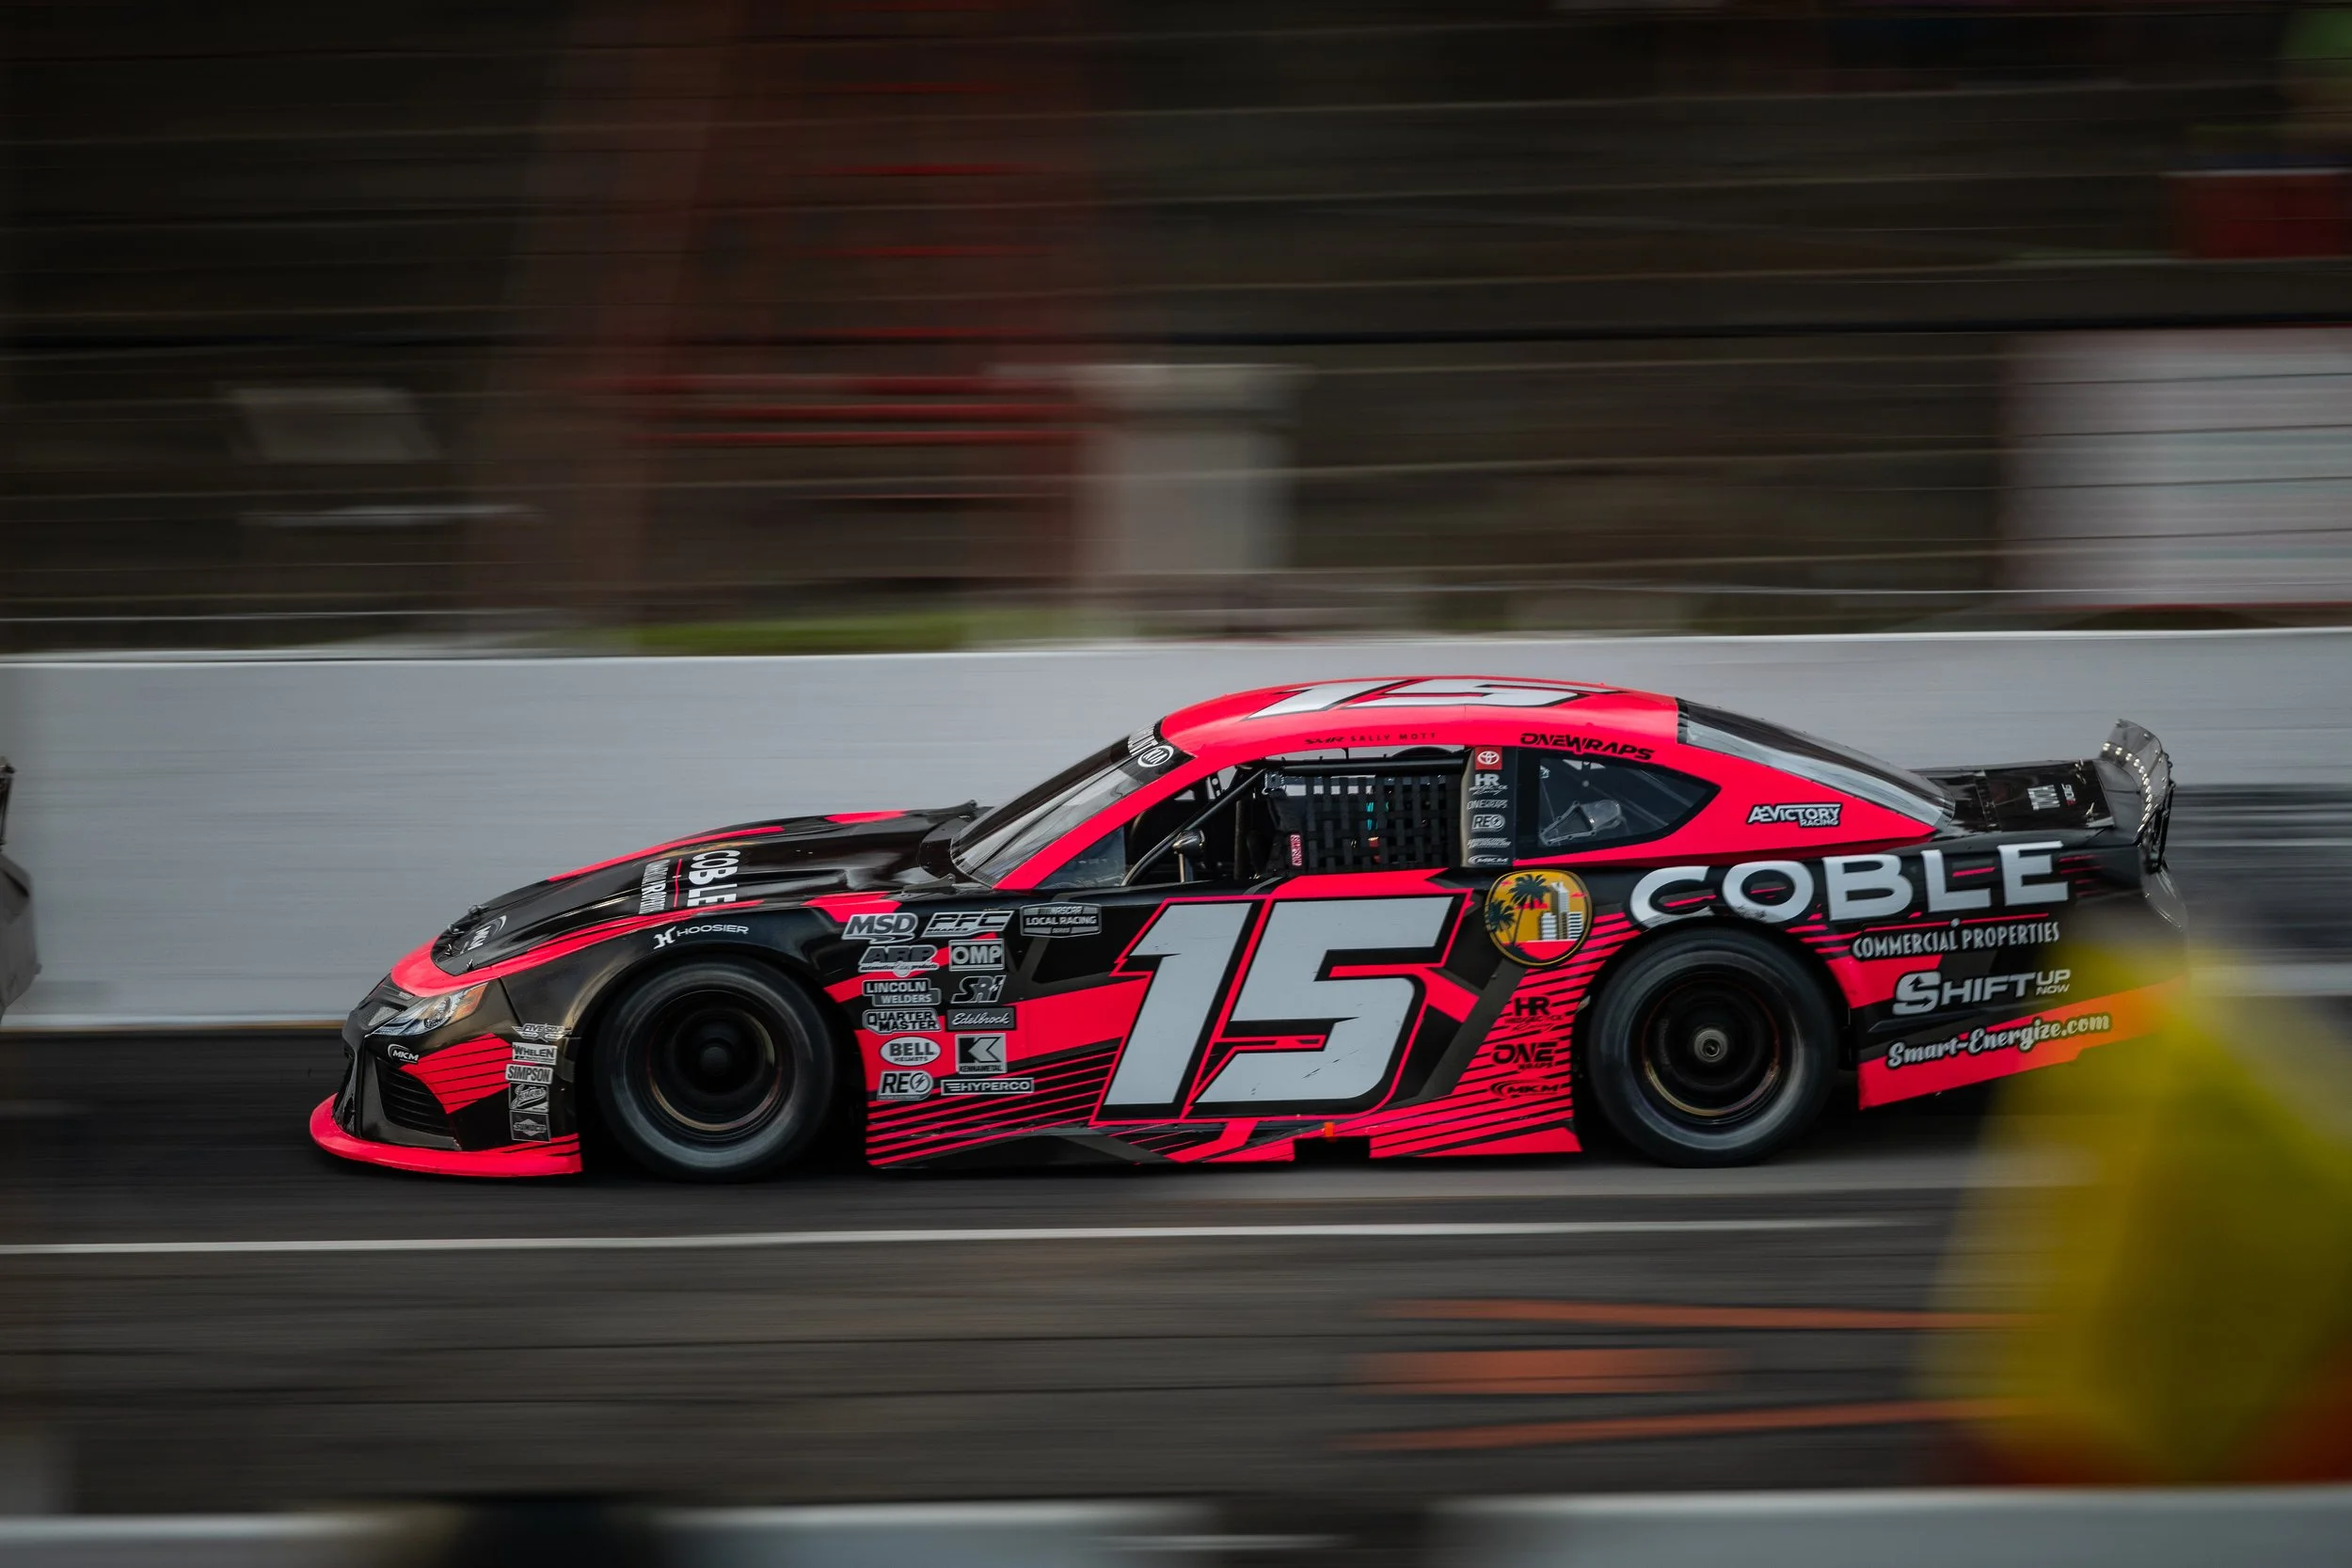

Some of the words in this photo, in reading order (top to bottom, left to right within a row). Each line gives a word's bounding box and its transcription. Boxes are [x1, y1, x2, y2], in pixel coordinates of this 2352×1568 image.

[1350, 734, 1391, 742] SALLY
[1399, 732, 1438, 740] MOTT
[1520, 733, 1656, 760] ONEWRAPS
[1475, 773, 1500, 786] HR
[1800, 818, 1839, 827] RACING
[687, 849, 741, 908] COBLE
[1629, 841, 2069, 929] COBLE
[847, 914, 916, 934] MSD
[932, 911, 1013, 927] PFC
[1025, 917, 1058, 926] LOCAL
[1059, 916, 1097, 925] RACING
[676, 924, 750, 937] HOOSIER
[1852, 929, 1959, 959] COMMERCIAL
[1962, 922, 2060, 950] PROPERTIES
[861, 946, 935, 964] ARP
[952, 944, 1003, 965] OMP
[866, 981, 927, 993] LINCOLN
[1892, 971, 2036, 1016] SHIFT
[2036, 969, 2071, 985] UP
[2036, 984, 2071, 996] NOW
[881, 993, 932, 1004] WELDERS
[1104, 896, 1454, 1105] 15
[1515, 996, 1549, 1016] HR
[866, 1011, 933, 1025] QUARTER
[952, 1012, 1010, 1025] Edelbrock
[522, 1023, 544, 1033] FIVE
[879, 1021, 937, 1032] MASTER
[1887, 1014, 2110, 1069] Smart-Energize.com
[392, 1050, 420, 1062] MKM
[514, 1045, 555, 1057] WHELEN
[889, 1042, 935, 1056] BELL
[1493, 1041, 1558, 1064] ONE
[508, 1065, 550, 1083] SIMPSON
[961, 1081, 1031, 1092] HYPERCO
[1508, 1084, 1559, 1094] MKM
